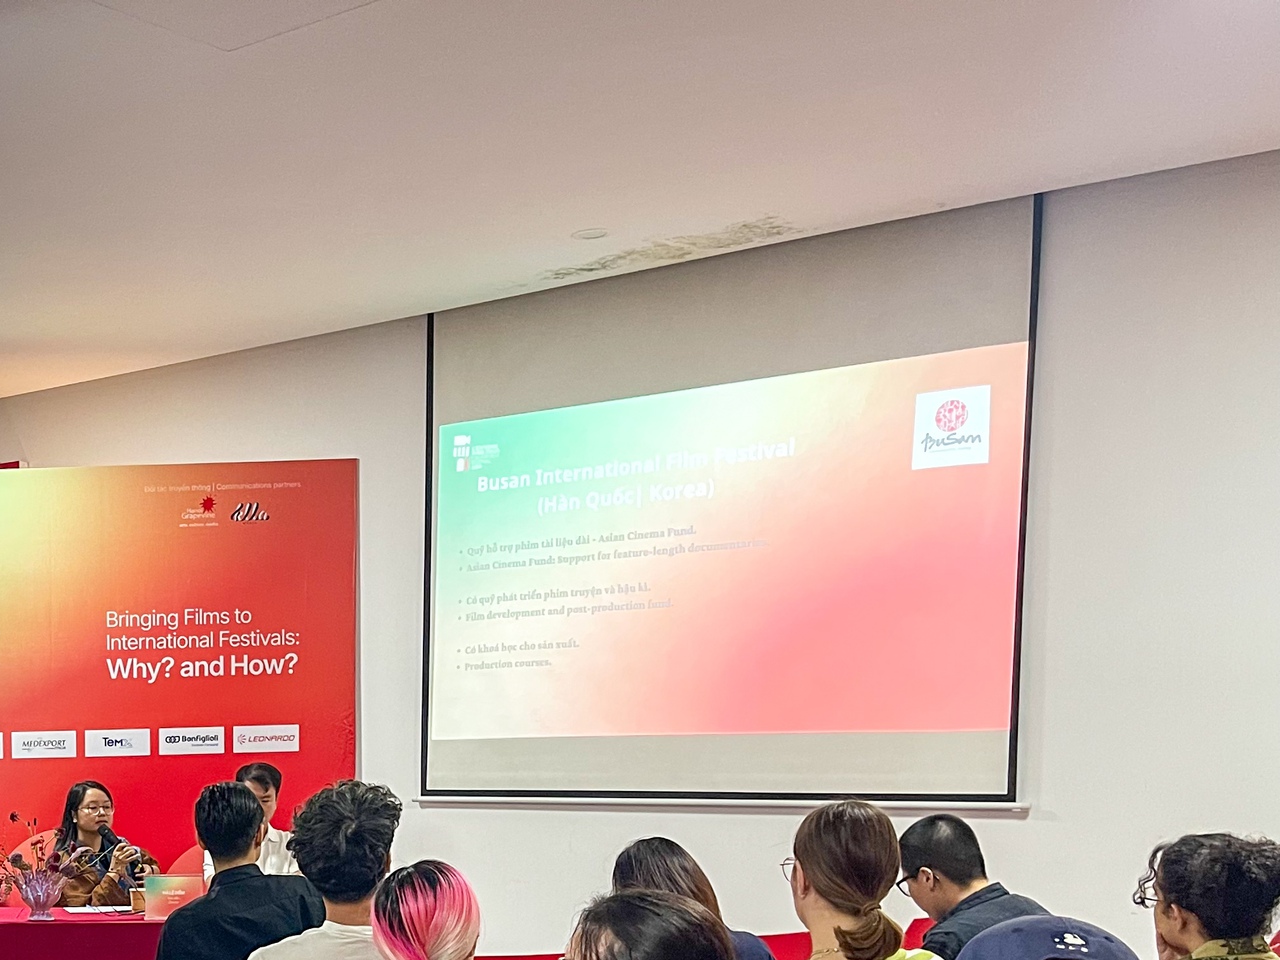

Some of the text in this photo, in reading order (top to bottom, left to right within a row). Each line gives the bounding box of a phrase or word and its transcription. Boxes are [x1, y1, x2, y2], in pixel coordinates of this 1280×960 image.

[477, 474, 531, 492] Busan
[535, 457, 660, 486] International
[666, 450, 708, 472] Film
[216, 483, 272, 491] Communications
[273, 482, 302, 491] partners
[537, 495, 581, 516] (Hàn
[649, 478, 716, 504] Korea)
[515, 541, 539, 554] phim
[598, 532, 625, 543] Asian
[627, 530, 665, 541] Cinema
[667, 525, 697, 538] Fund.
[467, 561, 490, 572] Asian
[492, 559, 526, 570] Cinema
[528, 556, 556, 567] Fund:
[557, 553, 596, 565] Support
[597, 550, 611, 561] for
[613, 543, 686, 560] feature-length
[543, 588, 569, 602] phim
[106, 608, 253, 631] Bringing Films to
[466, 611, 485, 622] Film
[486, 606, 546, 620] development
[547, 605, 565, 616] and
[567, 600, 646, 617] post-production
[106, 628, 300, 651] International Festivals:
[519, 640, 536, 651] cho
[106, 653, 299, 684] Why? and How?
[464, 657, 552, 671] Production courses.
[248, 734, 296, 743] LEONARDO
